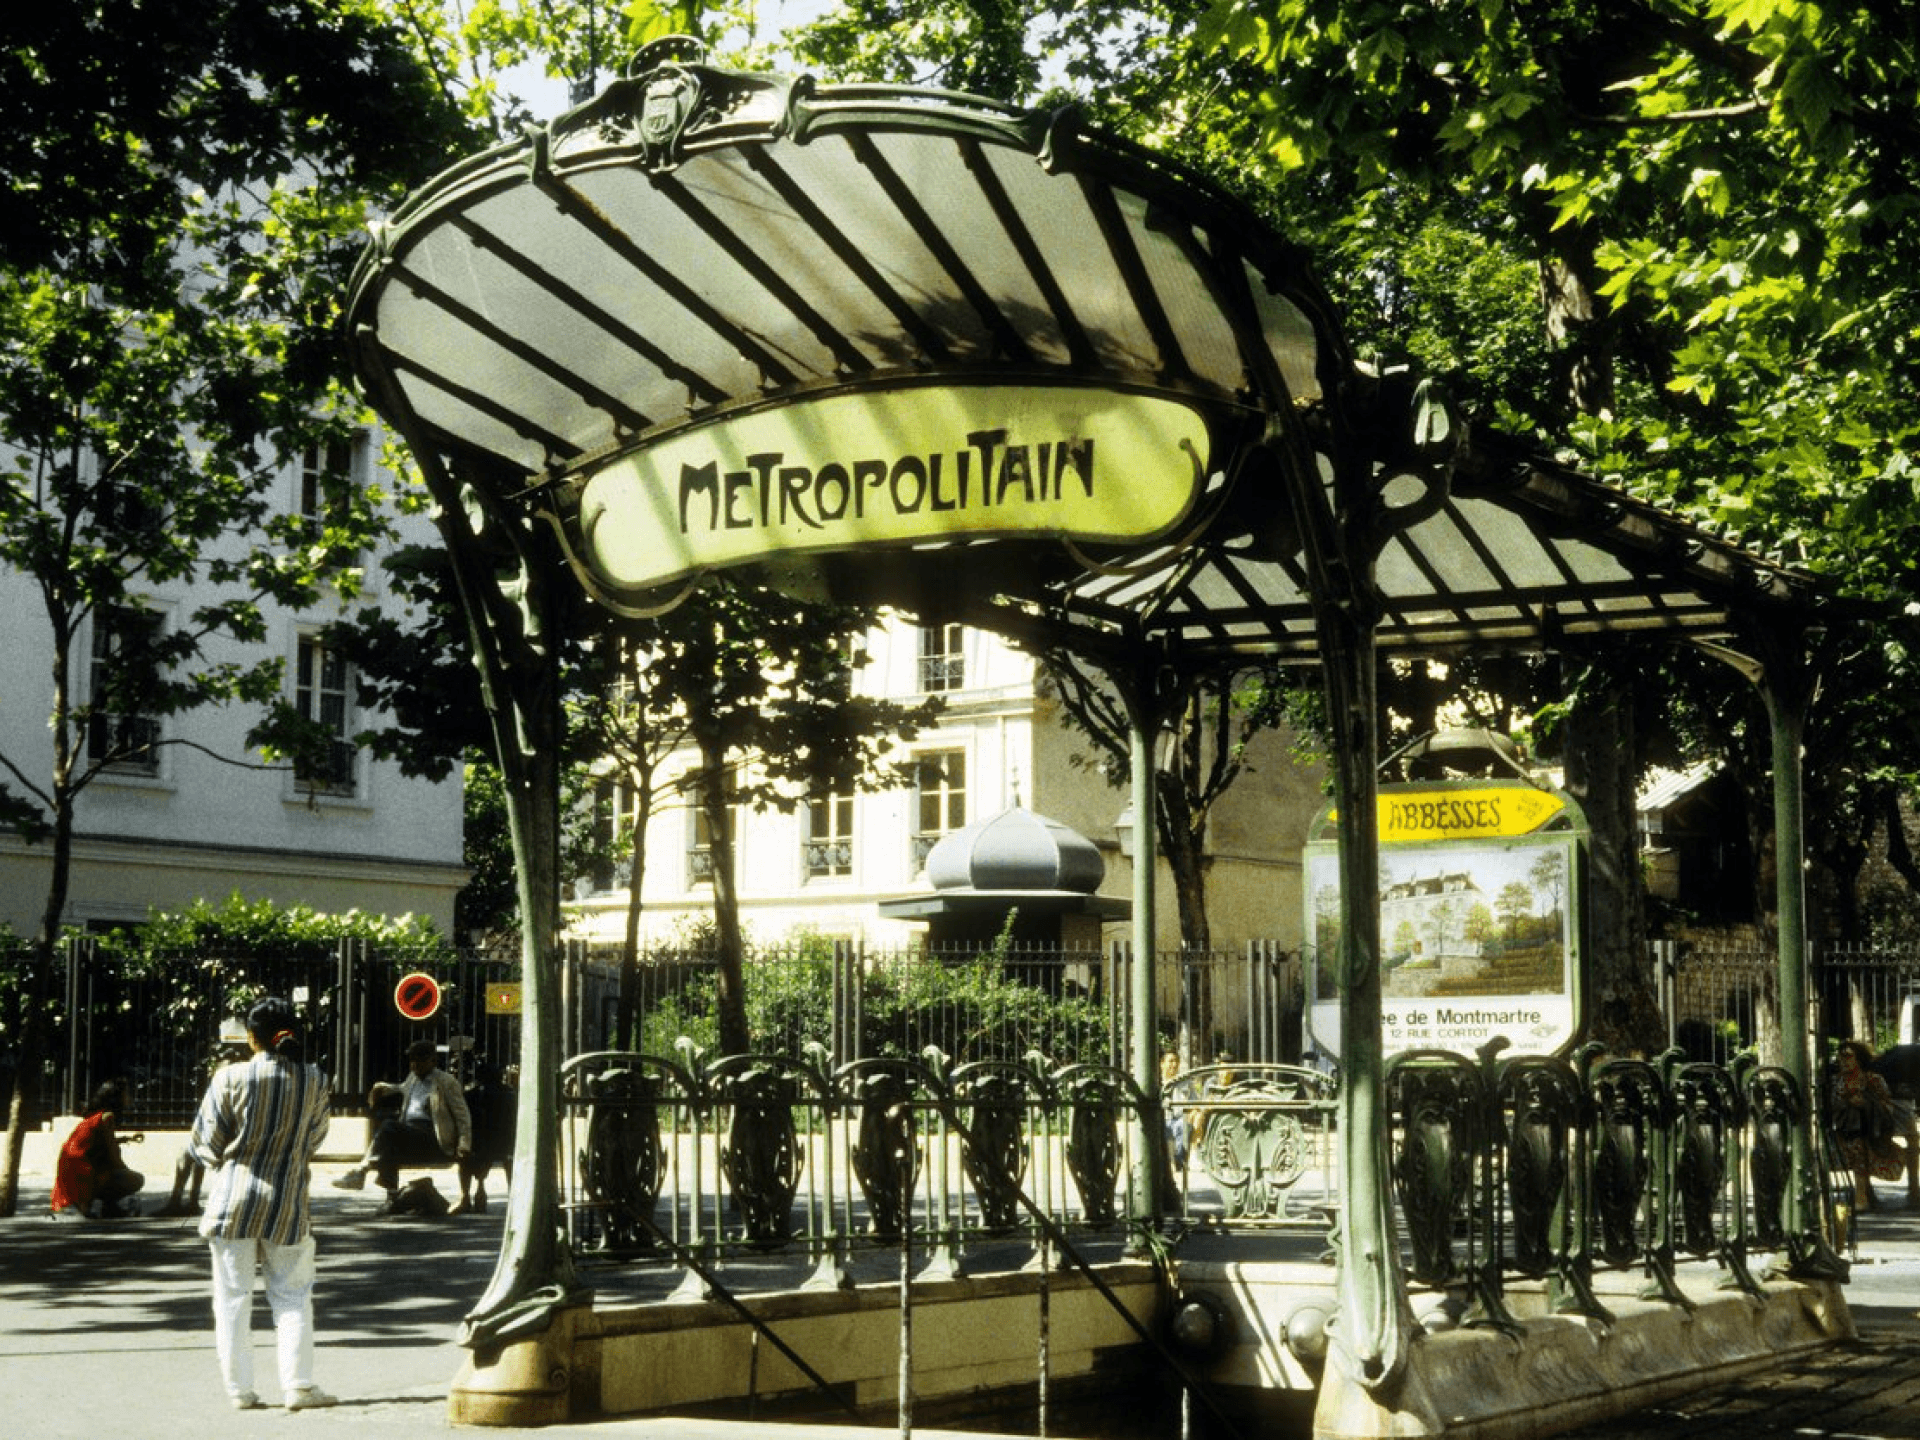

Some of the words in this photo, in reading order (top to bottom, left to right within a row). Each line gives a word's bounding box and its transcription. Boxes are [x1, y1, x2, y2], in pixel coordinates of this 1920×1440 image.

[678, 428, 1095, 535] METROPOLITAIN
[1388, 797, 1501, 831] ABBESSES
[1406, 1009, 1428, 1025] de
[1436, 1008, 1542, 1025] Montmartre
[1407, 1028, 1432, 1038] RUE
